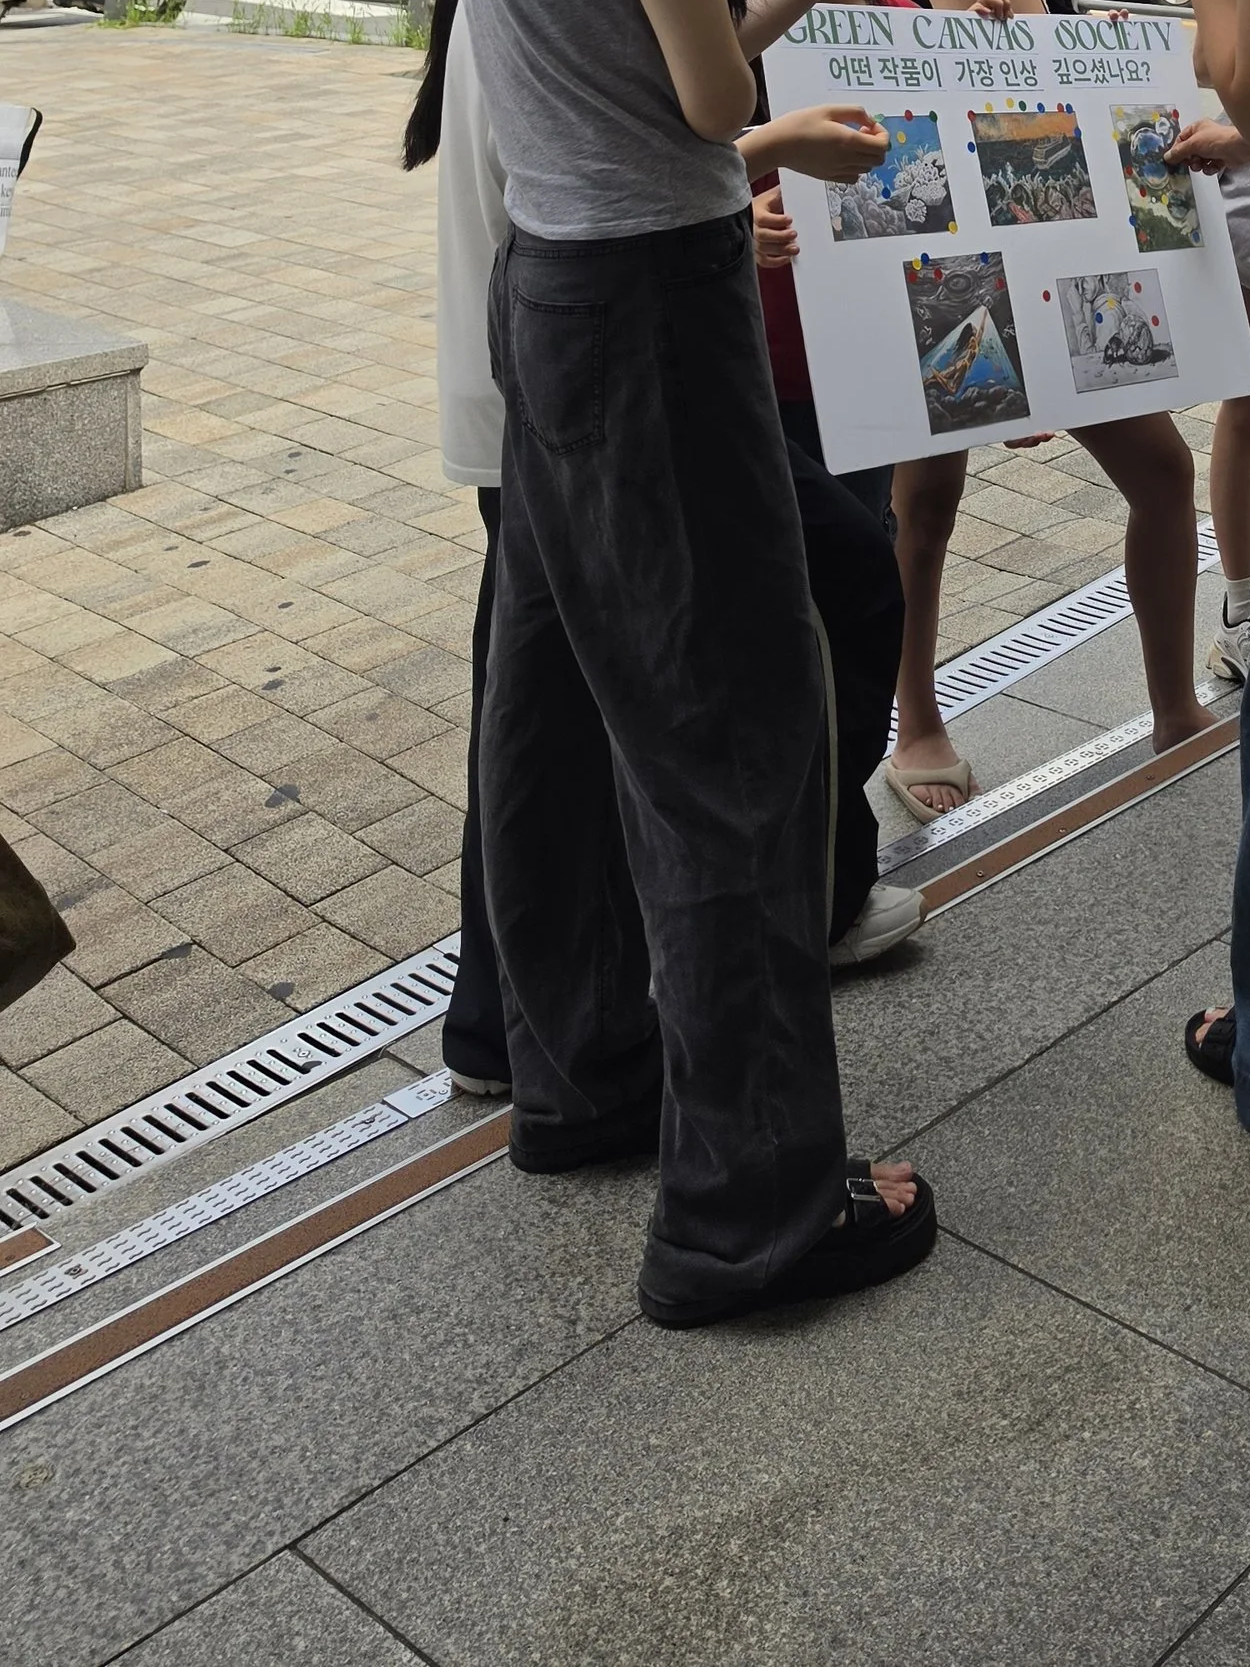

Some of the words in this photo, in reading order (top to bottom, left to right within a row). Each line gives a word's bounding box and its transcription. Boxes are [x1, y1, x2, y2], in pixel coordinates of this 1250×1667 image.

[912, 14, 1035, 51] CANVAS
[1054, 19, 1172, 51] SOCIETY
[828, 54, 874, 87] 어떤
[879, 56, 942, 88] 작품이
[955, 59, 995, 87] 가장
[999, 58, 1039, 87] 인상
[1052, 57, 1151, 86] 깊으셨나요?
